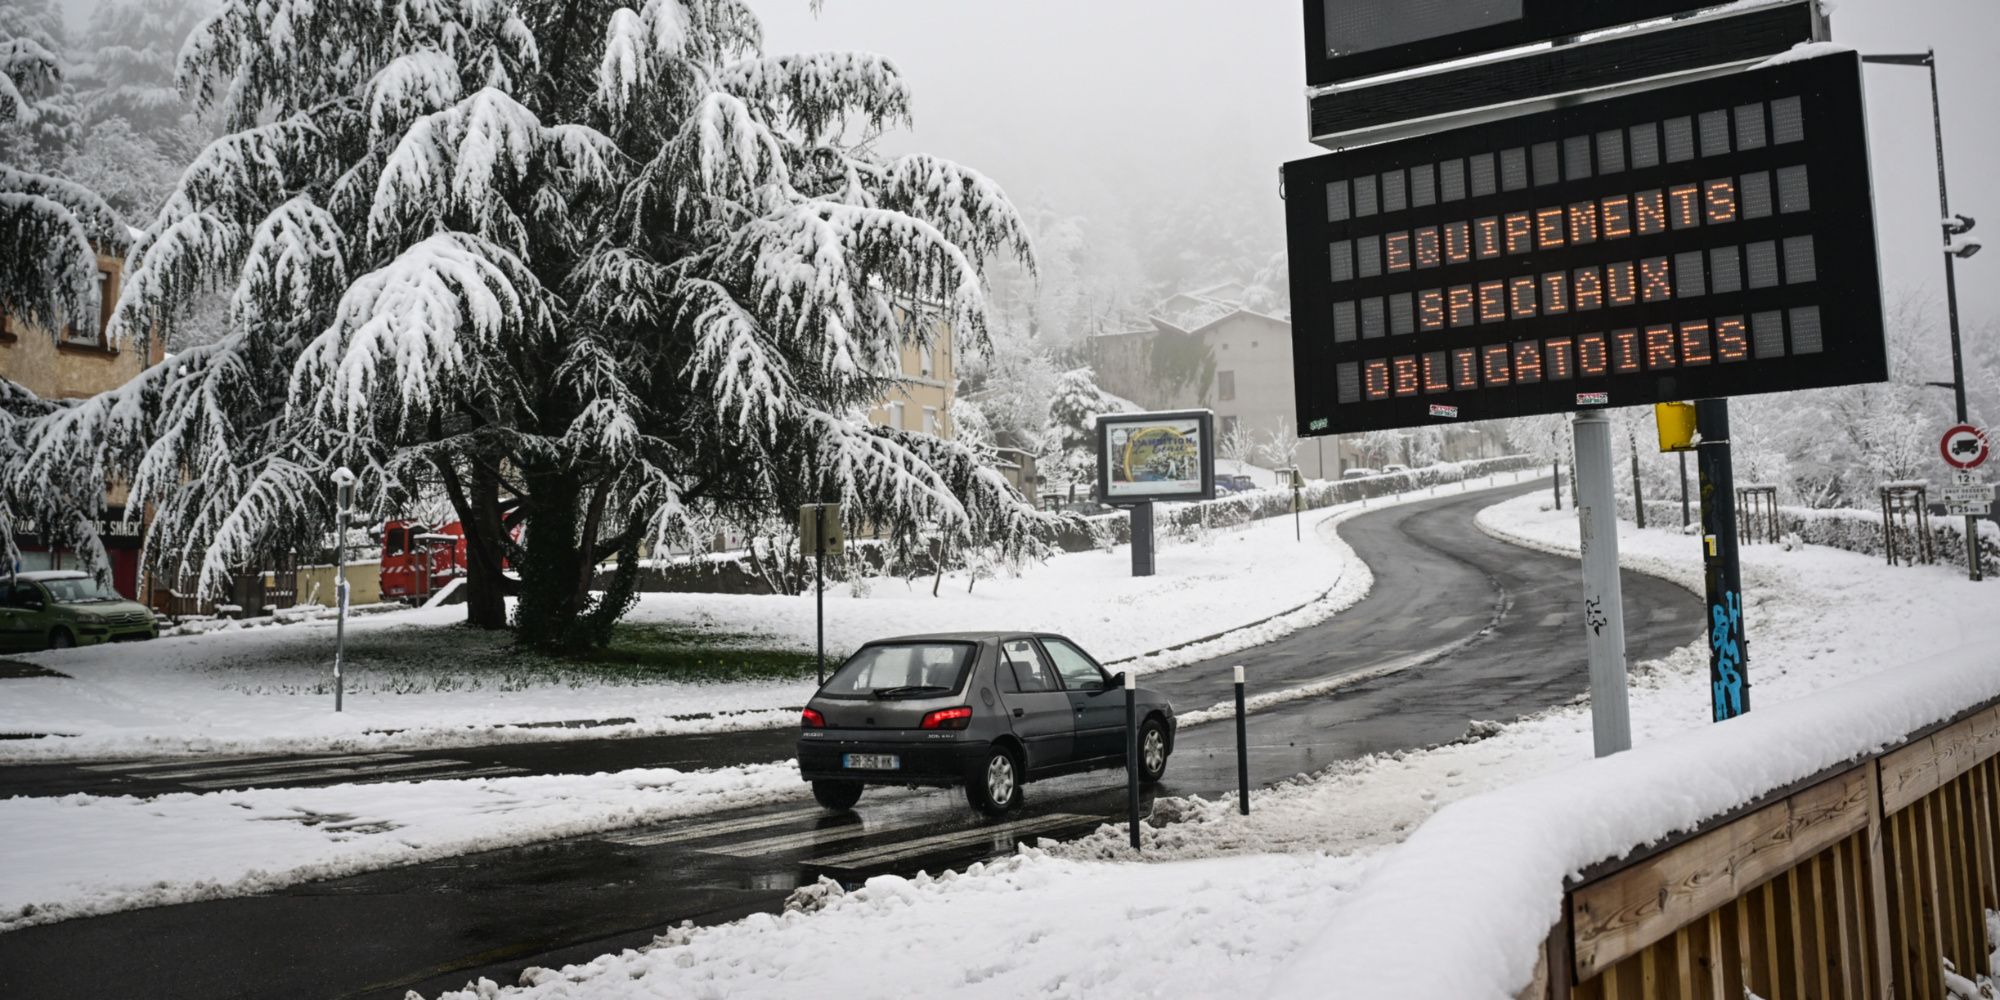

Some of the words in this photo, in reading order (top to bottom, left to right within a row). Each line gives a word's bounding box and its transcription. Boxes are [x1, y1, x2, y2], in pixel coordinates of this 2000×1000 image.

[1387, 183, 1735, 270] EQUIPEMENTS
[1419, 259, 1670, 327] SPECIAUX
[1366, 320, 1747, 396] OBLIGATOIRES
[1958, 474, 1970, 483] 12
[110, 520, 139, 536] SNACK
